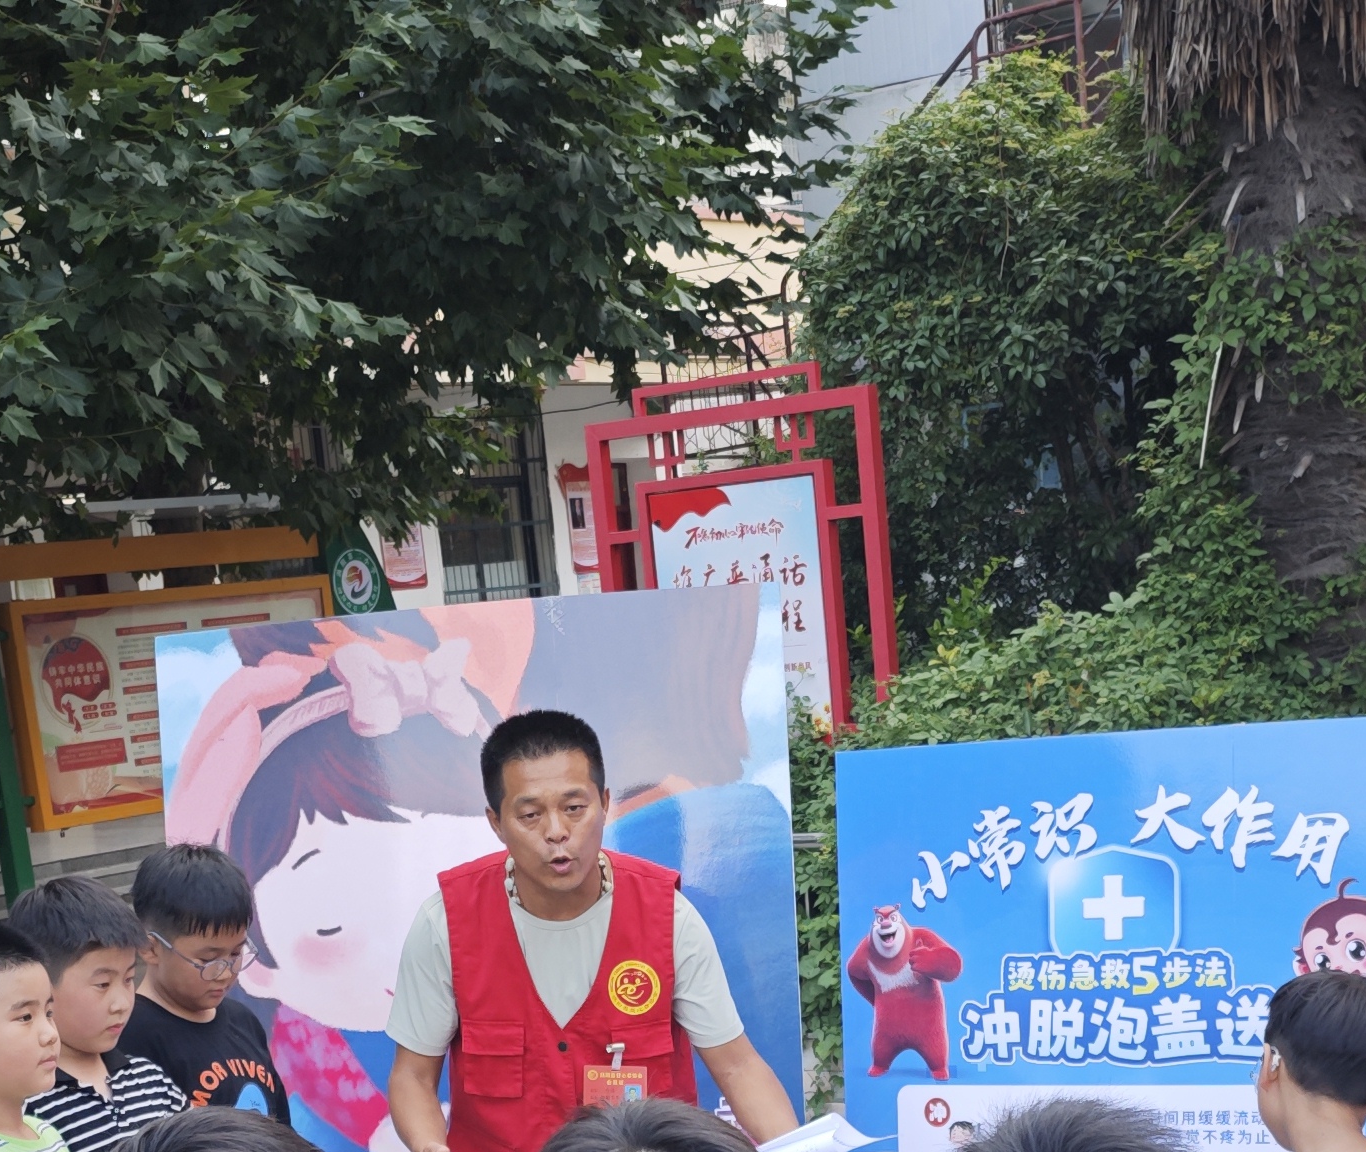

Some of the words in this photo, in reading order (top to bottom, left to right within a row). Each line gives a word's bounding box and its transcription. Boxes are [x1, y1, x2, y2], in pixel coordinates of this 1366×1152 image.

[910, 792, 1098, 909] 小常识
[1130, 784, 1351, 885] 大作用
[1007, 953, 1228, 996] 烫伤急救5步法
[966, 994, 1270, 1063] 冲脱泡盖送
[929, 1102, 948, 1123] 冲
